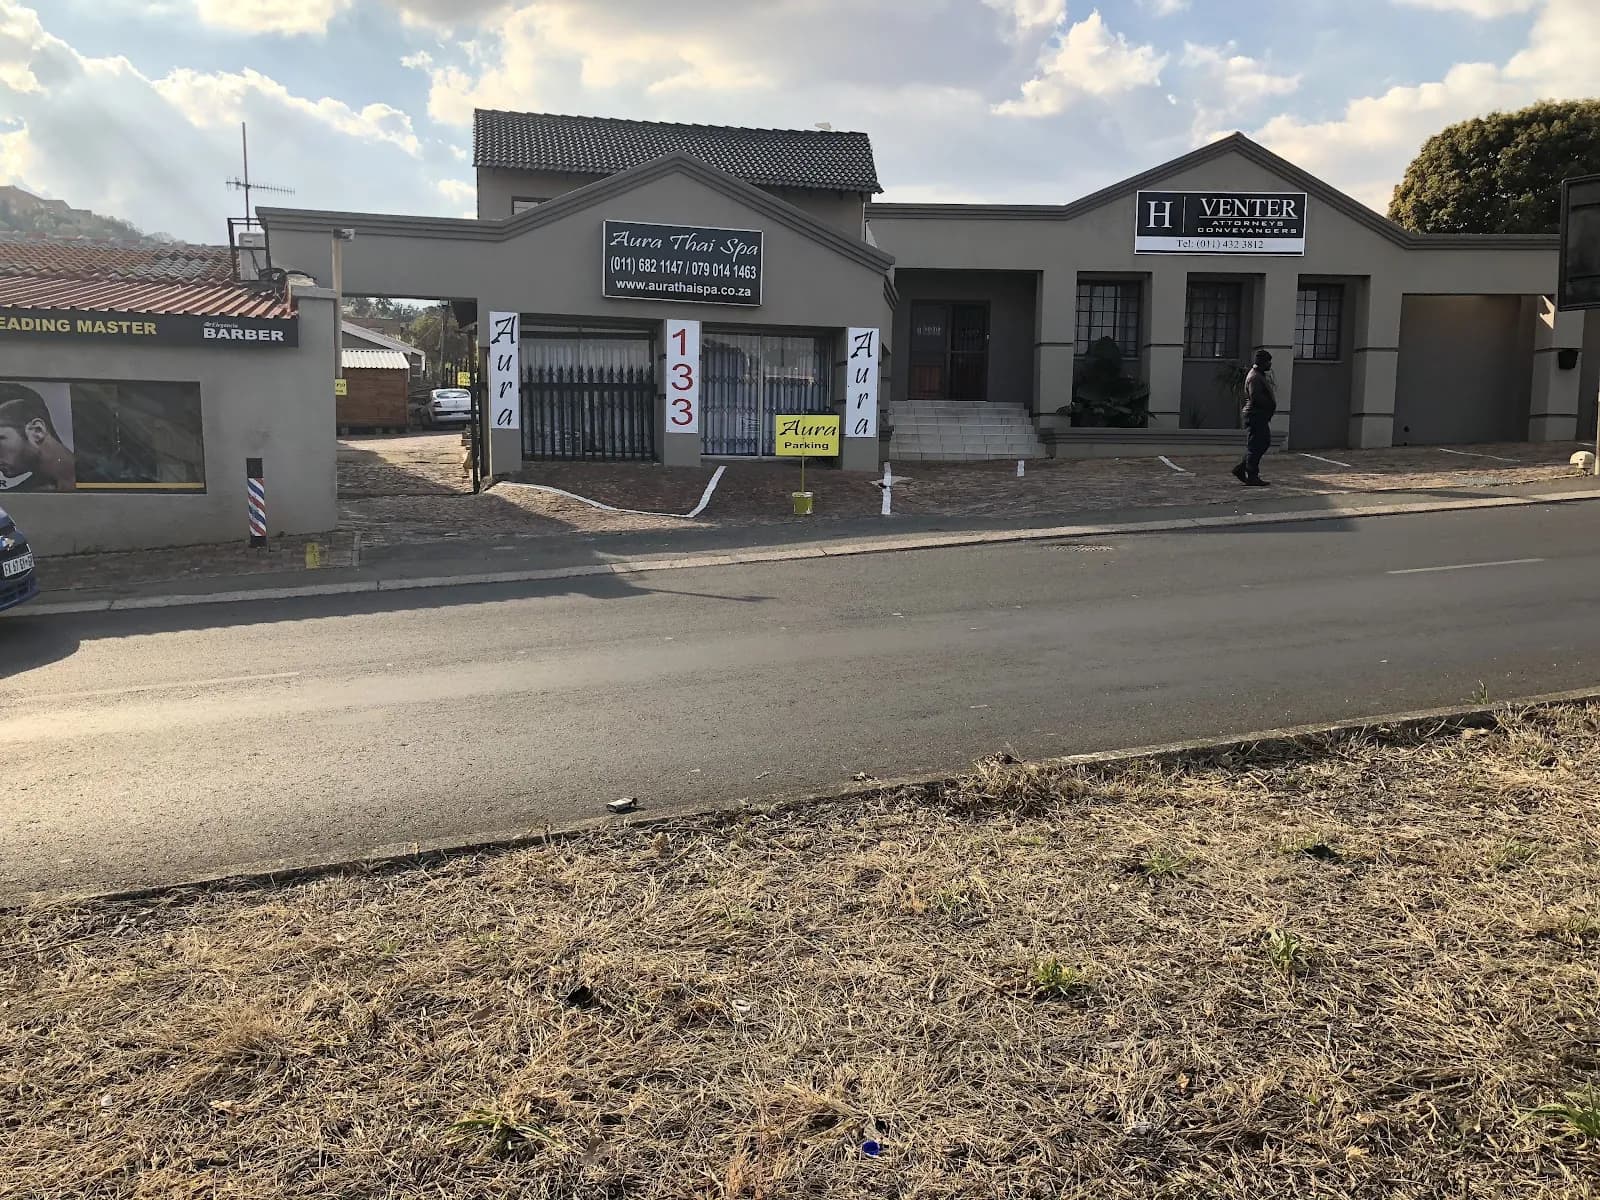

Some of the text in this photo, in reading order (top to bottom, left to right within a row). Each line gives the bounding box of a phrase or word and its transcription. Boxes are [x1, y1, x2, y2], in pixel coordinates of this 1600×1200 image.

[1145, 200, 1173, 228] H
[1200, 198, 1298, 217] VENTER
[609, 231, 758, 263] Aura Thai Spa
[1177, 239, 1264, 250] Tel: (011) 432 3812
[610, 256, 757, 280] (011) 682 1147 / 079 014 1463
[616, 280, 752, 297] www.aurathaispa.co.za
[77, 319, 158, 335] MASTER
[203, 327, 285, 341] BARBER
[490, 315, 517, 427] Aura
[670, 328, 694, 426] 133
[850, 331, 875, 435] Aura
[779, 419, 837, 436] Aura
[784, 442, 829, 450] Parking
